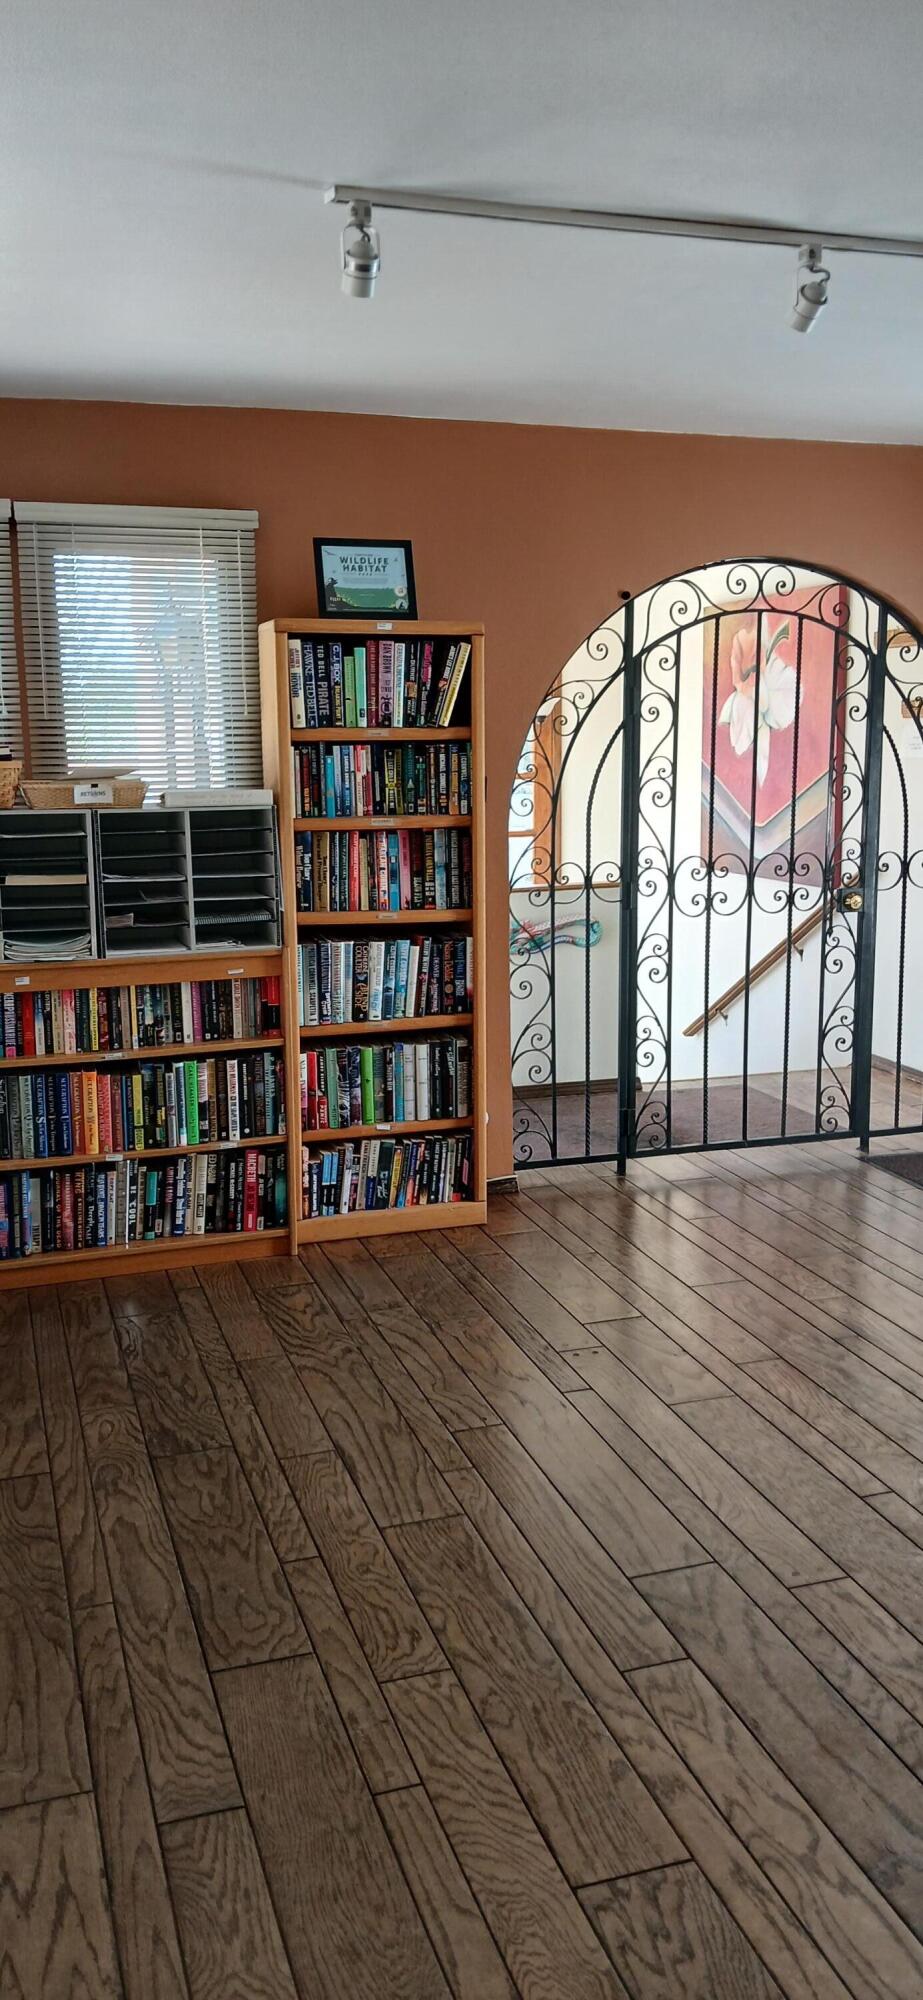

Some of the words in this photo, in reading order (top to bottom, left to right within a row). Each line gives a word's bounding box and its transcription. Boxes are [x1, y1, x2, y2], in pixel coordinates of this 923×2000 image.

[339, 556, 390, 565] WILDLIFE
[343, 565, 388, 573] HABITAT
[304, 645, 313, 677] HAWKE
[318, 661, 326, 677] BELL
[333, 663, 342, 683] BOX
[290, 672, 299, 699] HONOR
[306, 681, 315, 699] TED
[307, 699, 316, 718] BELL
[317, 682, 330, 715] PIRATE
[296, 846, 304, 866] Without
[304, 853, 312, 864] Tom
[302, 864, 312, 881] Clancy
[355, 946, 363, 974] COULTER
[444, 941, 454, 961] Nelson
[444, 961, 454, 983] DeMille
[208, 1154, 217, 1164] ED
[247, 1153, 257, 1183] MACBETH
[361, 1155, 369, 1174] FRENCH
[207, 1164, 216, 1184] McBAIN
[130, 1185, 136, 1194] BE
[56, 1204, 61, 1213] OF
[87, 1205, 95, 1227] Deeply
[32, 1225, 41, 1247] THERAPY
